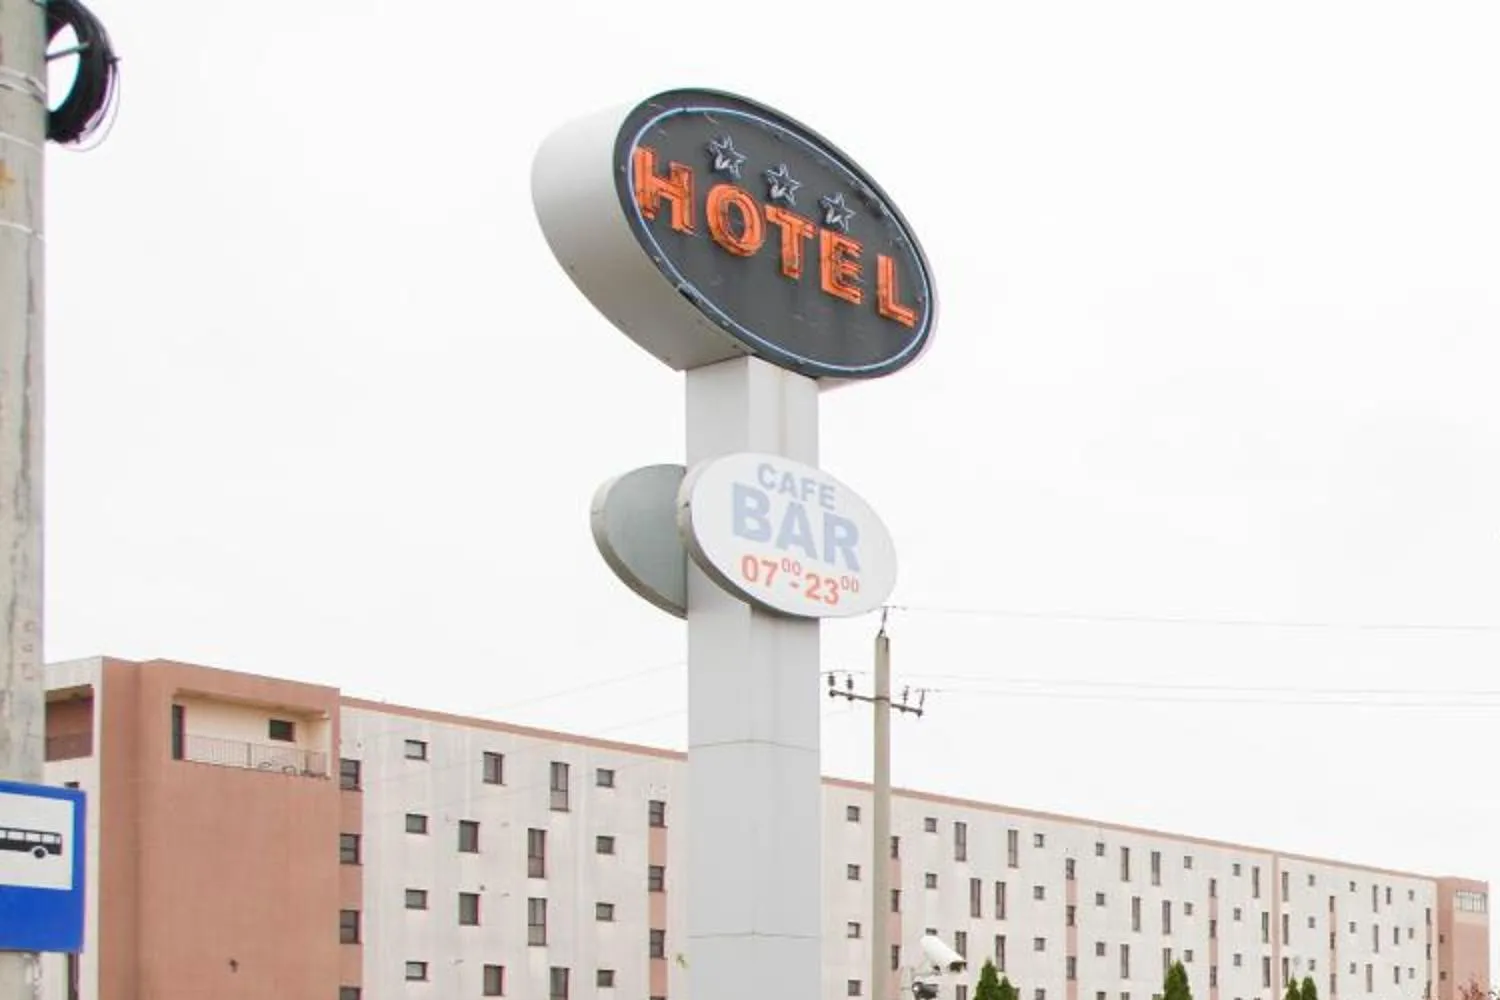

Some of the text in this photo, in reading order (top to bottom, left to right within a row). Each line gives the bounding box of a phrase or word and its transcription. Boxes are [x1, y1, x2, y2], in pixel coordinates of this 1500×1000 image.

[632, 145, 916, 329] HOTEL
[731, 481, 861, 573] BAR
[757, 462, 836, 511] CAFE
